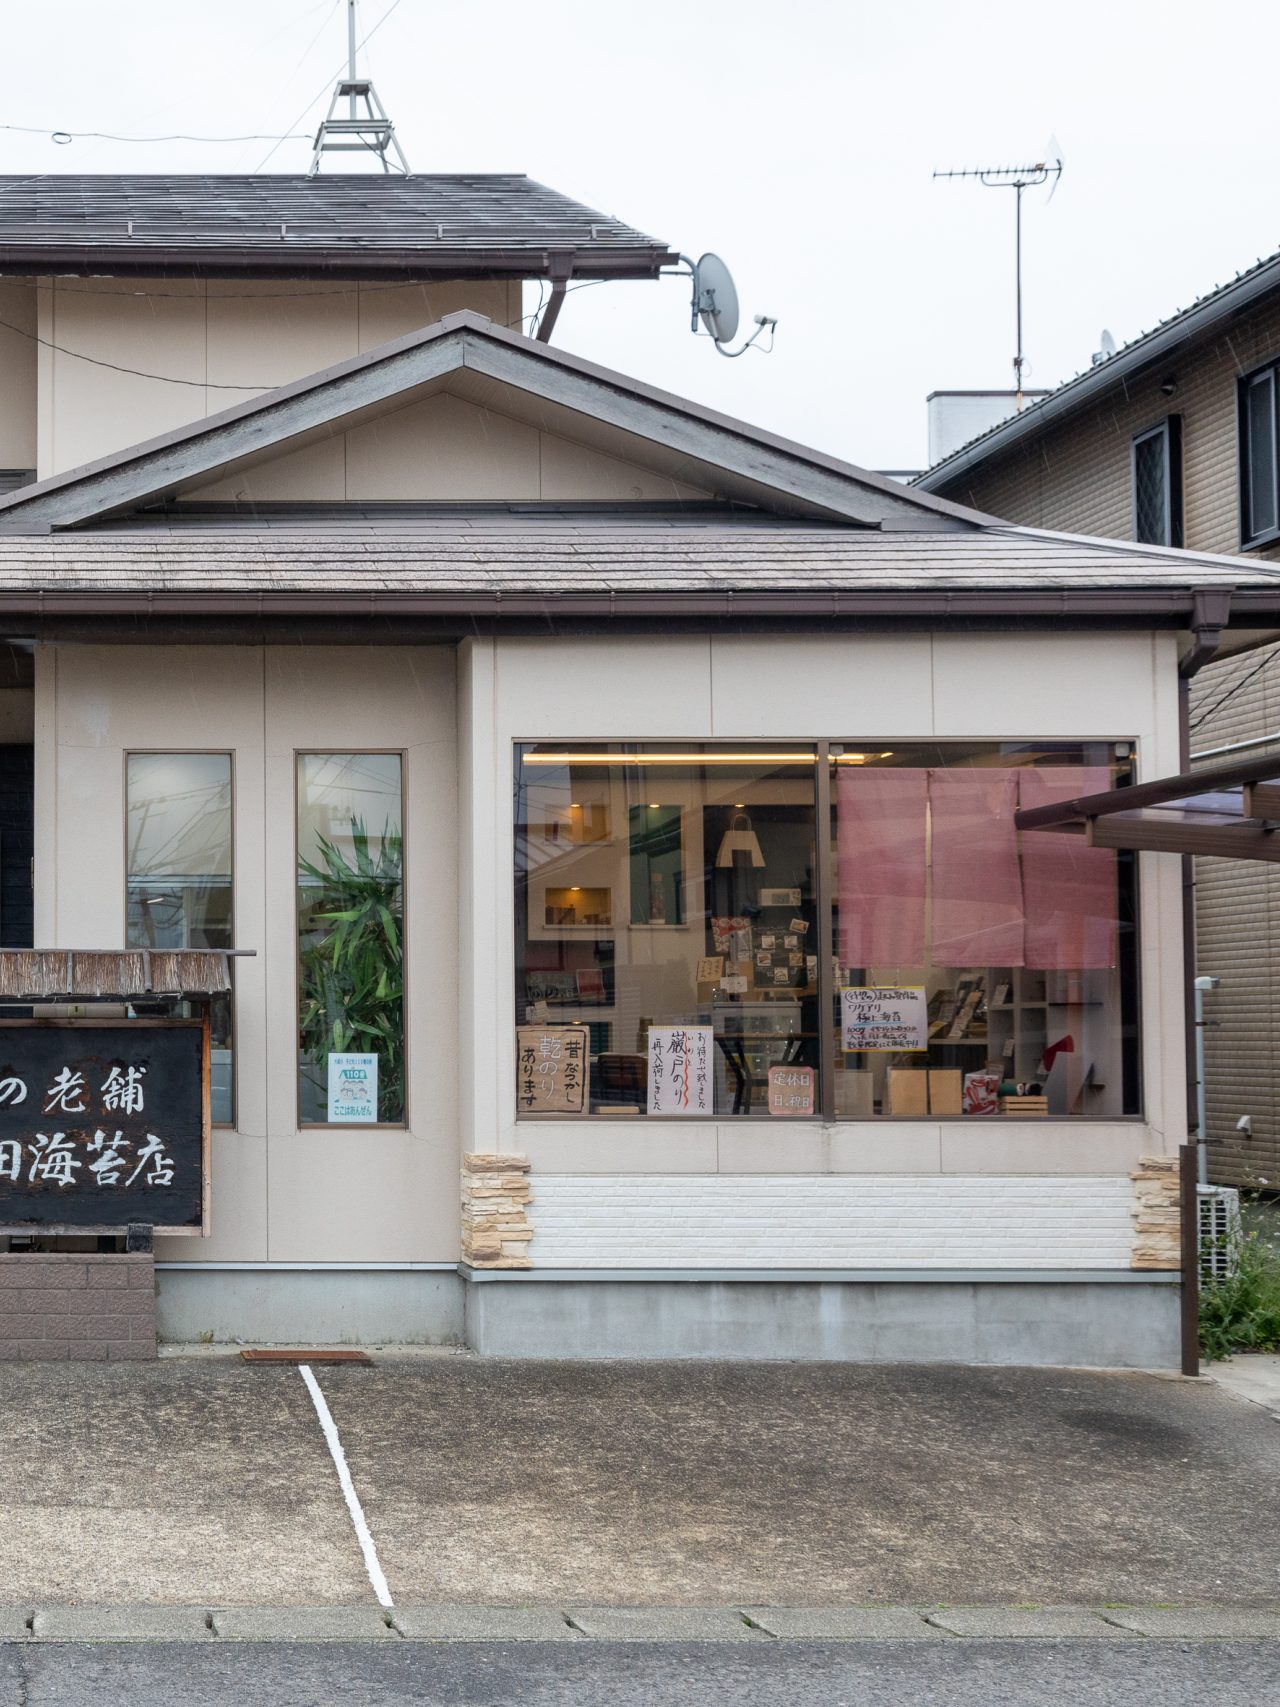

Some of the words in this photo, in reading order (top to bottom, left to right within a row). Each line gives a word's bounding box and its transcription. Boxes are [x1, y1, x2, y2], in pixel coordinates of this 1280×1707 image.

[520, 1047, 537, 1106] あります
[537, 1035, 561, 1100] 乾のり
[564, 1040, 582, 1103] 昔なつかし
[773, 1071, 810, 1087] 定休日
